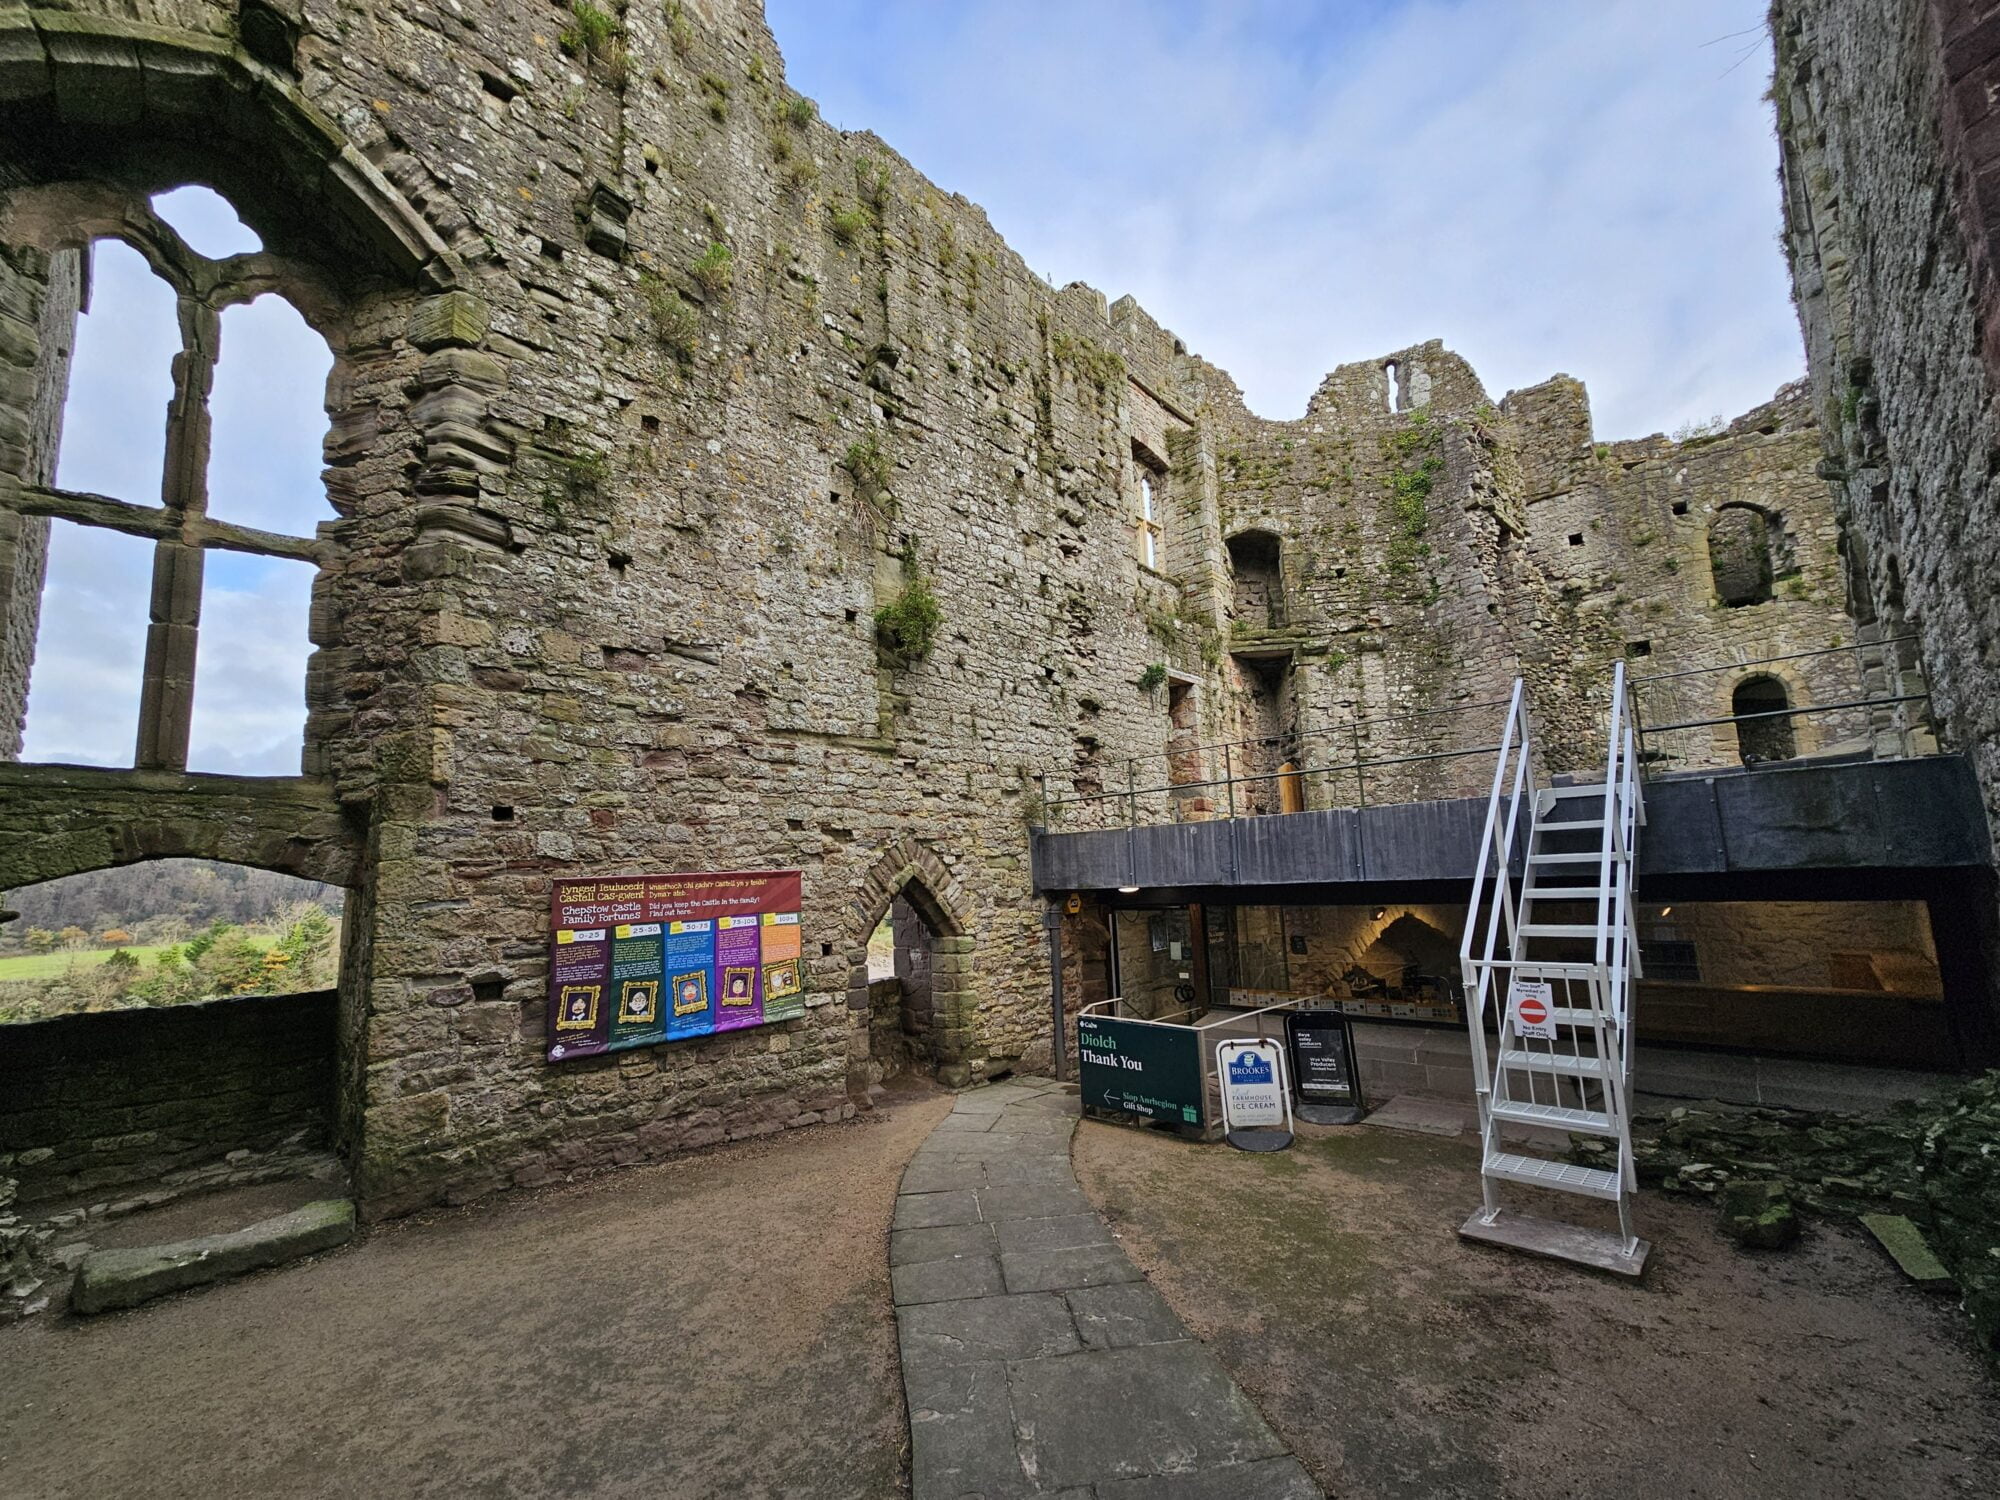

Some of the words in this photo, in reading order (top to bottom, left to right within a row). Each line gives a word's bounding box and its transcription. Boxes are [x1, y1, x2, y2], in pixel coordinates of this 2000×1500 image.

[561, 883, 596, 895] Tynged
[683, 881, 694, 889] chi
[715, 880, 735, 888] Castell
[559, 892, 595, 903] Castell
[597, 891, 645, 901] Cas-gwent
[562, 904, 610, 916] Chepstow
[611, 902, 641, 912] Castle
[649, 902, 660, 910] Did
[661, 903, 673, 911] you
[674, 901, 689, 910] keep
[562, 914, 596, 924] Family
[599, 911, 641, 922] Fortunes
[648, 909, 663, 918] Find
[664, 909, 675, 917] out
[732, 918, 755, 926] 75-100
[633, 926, 658, 934] 25-50
[1081, 1032, 1117, 1050] Diolch
[1081, 1049, 1119, 1067] Thank
[1120, 1055, 1143, 1071] You
[1122, 1091, 1138, 1102] Siop
[1123, 1101, 1136, 1110] Gift
[1136, 1103, 1154, 1115] Shop
[1248, 1102, 1276, 1110] CREAM
